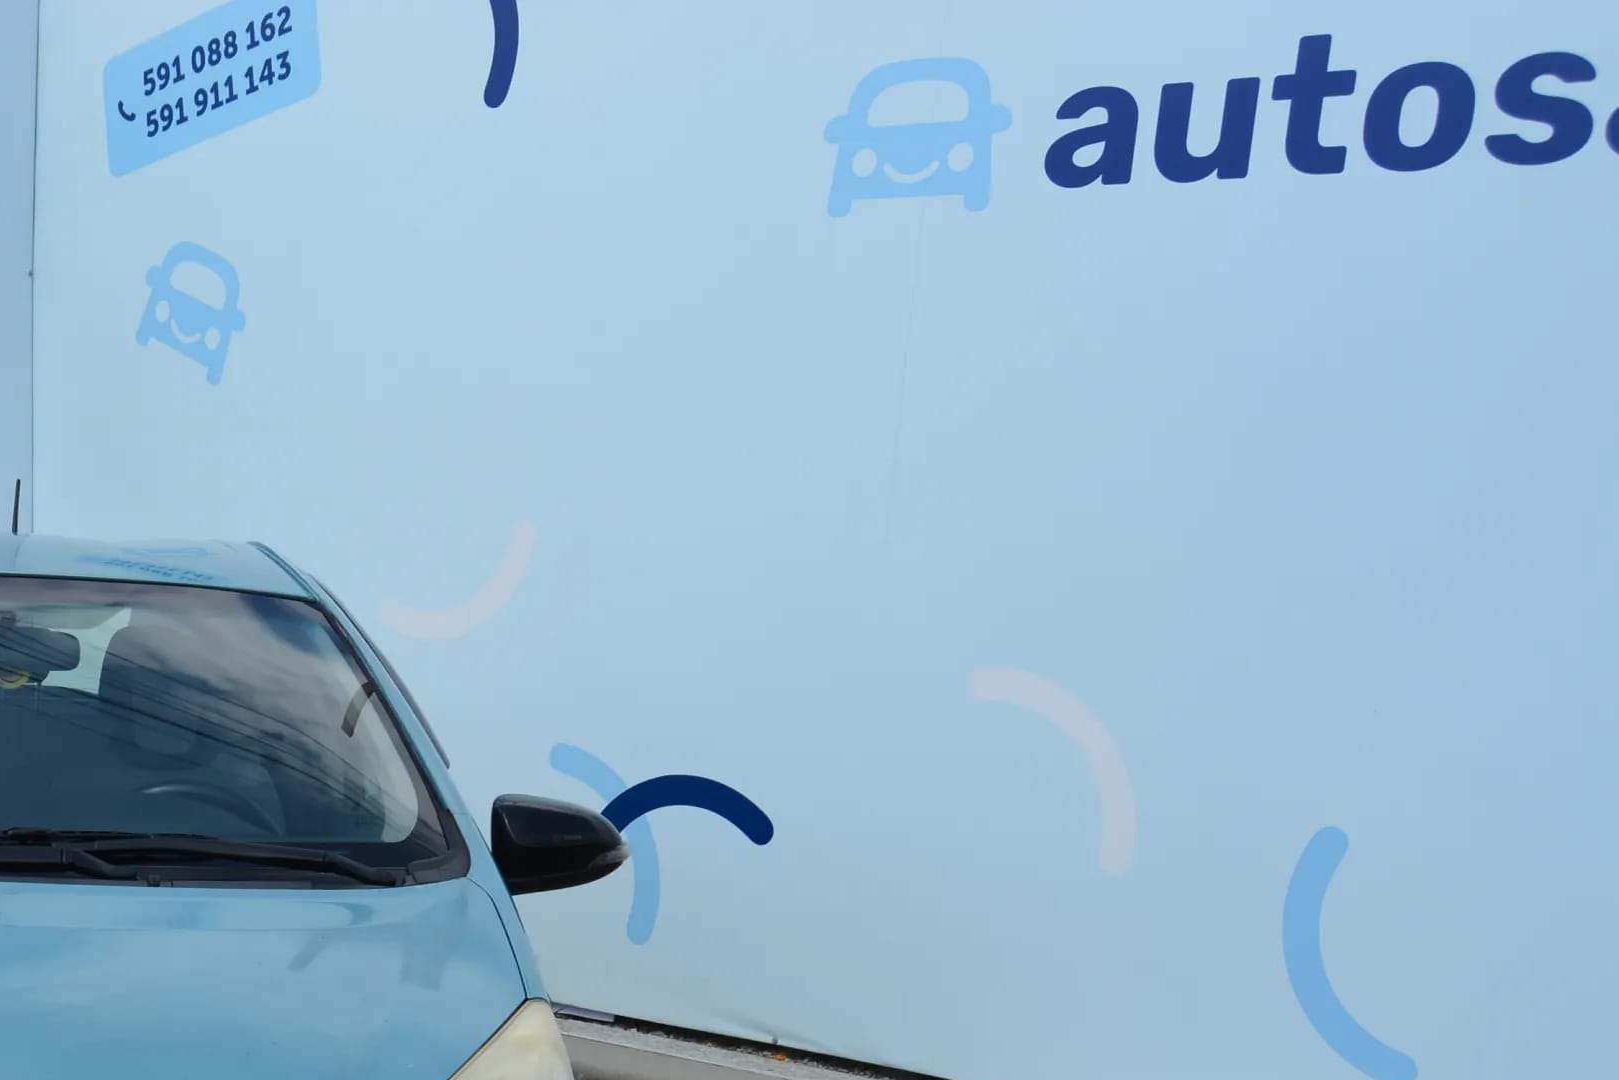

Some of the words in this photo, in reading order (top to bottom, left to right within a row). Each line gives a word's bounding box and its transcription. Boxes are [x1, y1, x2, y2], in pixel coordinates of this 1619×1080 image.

[143, 55, 186, 97] 591
[191, 30, 238, 74] 088
[245, 5, 293, 51] 162
[146, 96, 189, 138] 591
[193, 74, 238, 118] 911
[244, 50, 292, 96] 143
[1043, 33, 1619, 189] autos
